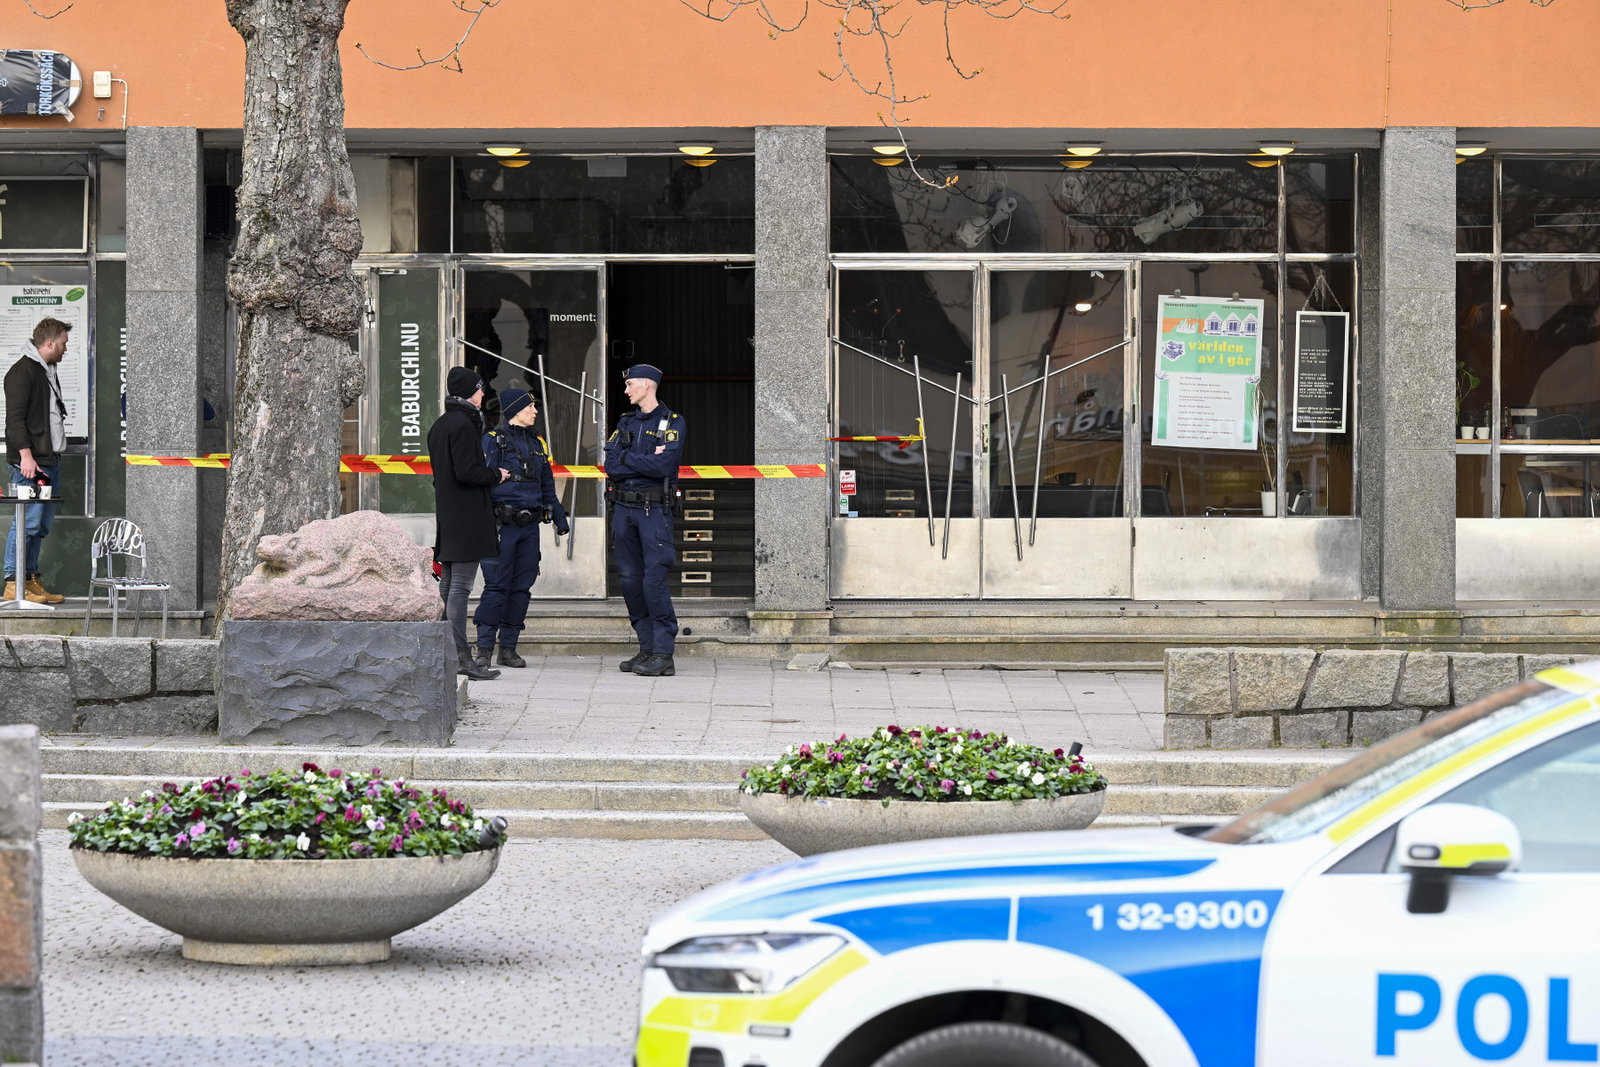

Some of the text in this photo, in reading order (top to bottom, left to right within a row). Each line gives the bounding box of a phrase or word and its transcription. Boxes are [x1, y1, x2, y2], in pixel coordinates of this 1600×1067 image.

[549, 313, 597, 322] moment:
[1188, 340, 1244, 353] världen
[1198, 356, 1216, 364] av
[1227, 355, 1252, 367] går
[400, 322, 421, 437] BABURCHI.NU
[1086, 900, 1268, 931] 1 32-9300
[1376, 973, 1598, 1062] POL
